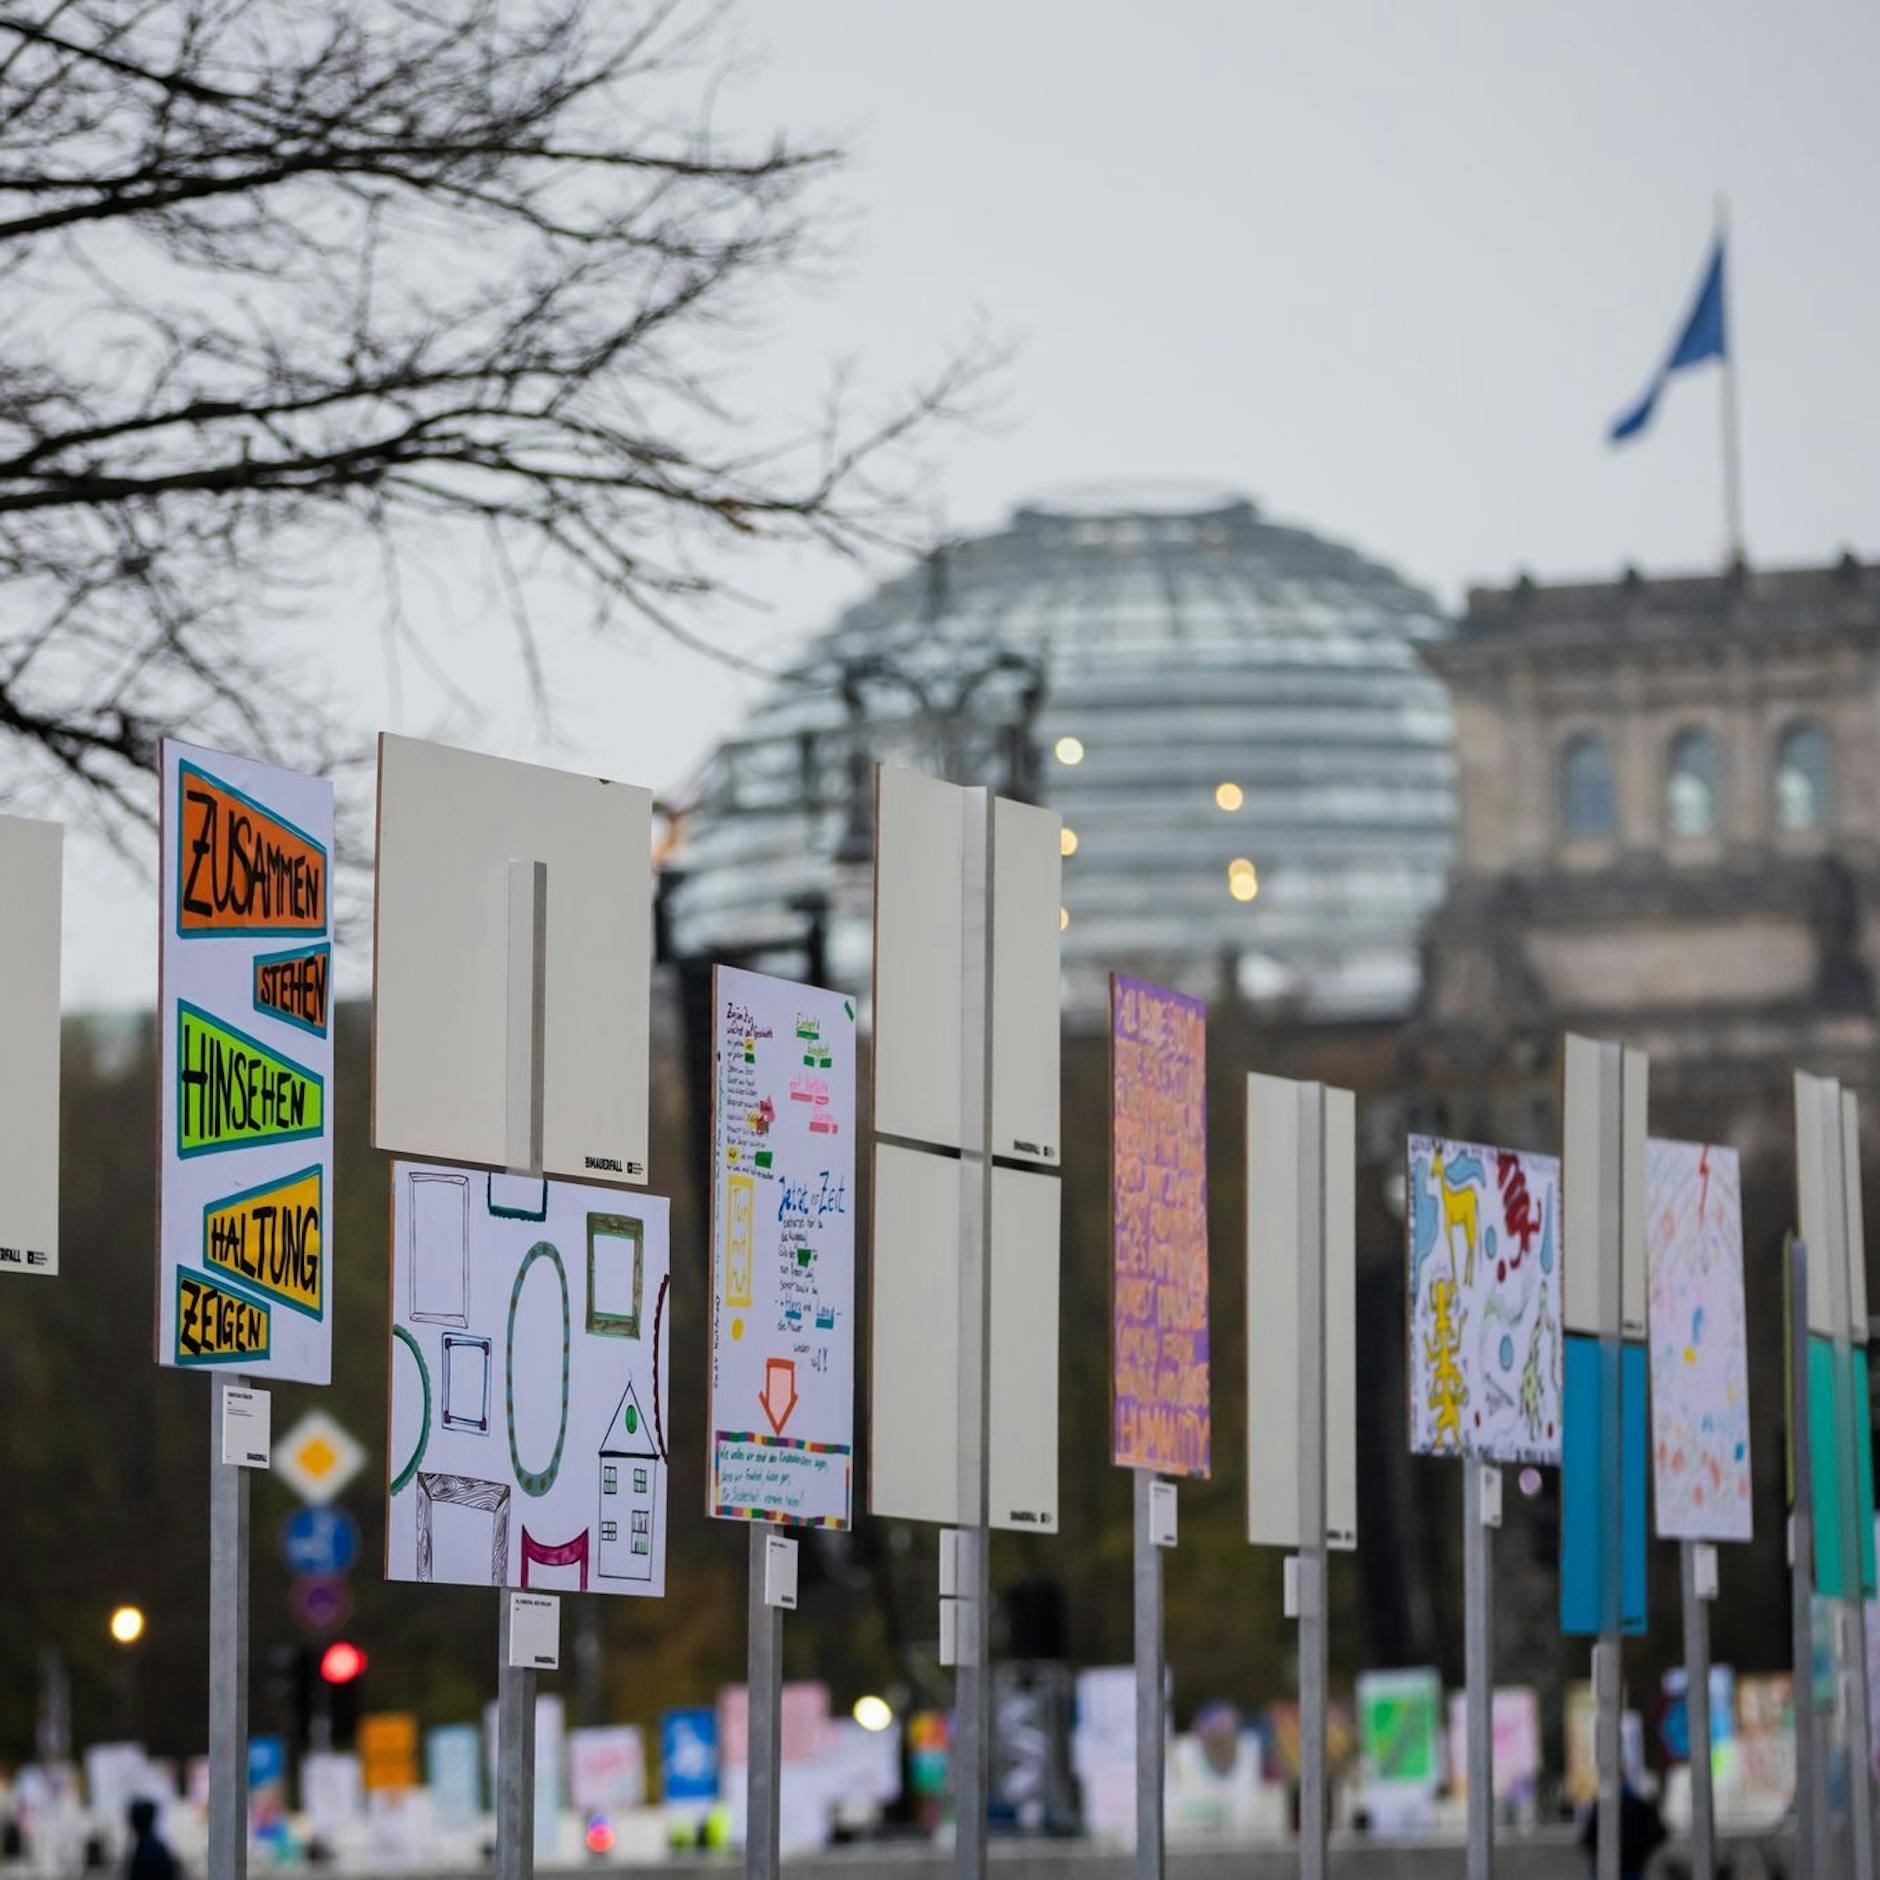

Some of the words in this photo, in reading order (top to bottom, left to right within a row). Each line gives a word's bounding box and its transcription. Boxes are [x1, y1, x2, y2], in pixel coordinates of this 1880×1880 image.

[184, 790, 319, 918] ZUSAMMEN
[261, 956, 327, 1024] STEHEN
[182, 1024, 306, 1138] HINSEHEN
[211, 1205, 318, 1295] HALTUNG
[181, 1280, 261, 1355] ZEIGEN
